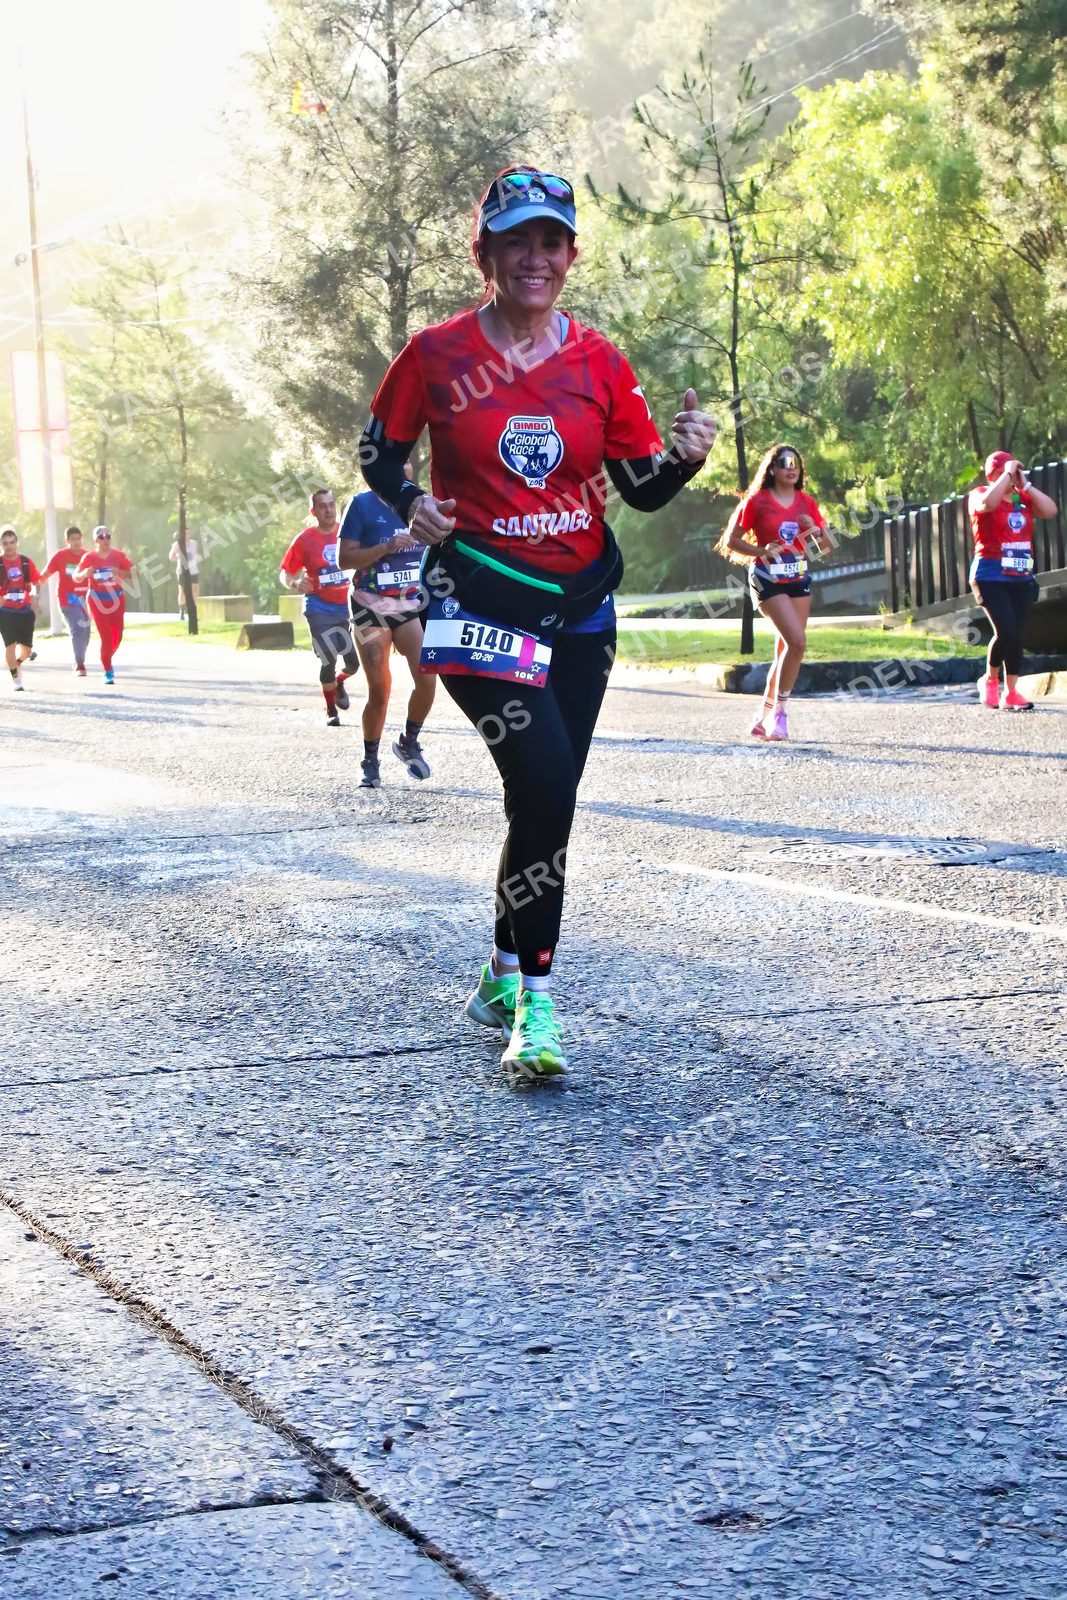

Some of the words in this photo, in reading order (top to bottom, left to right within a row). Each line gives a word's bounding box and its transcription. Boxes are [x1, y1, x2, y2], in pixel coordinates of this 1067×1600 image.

[514, 422, 548, 430] BIMBO
[515, 434, 548, 446] Global
[509, 445, 535, 455] Race
[393, 571, 412, 583] 5741
[460, 622, 514, 653] 5140
[514, 671, 535, 680] 10K
